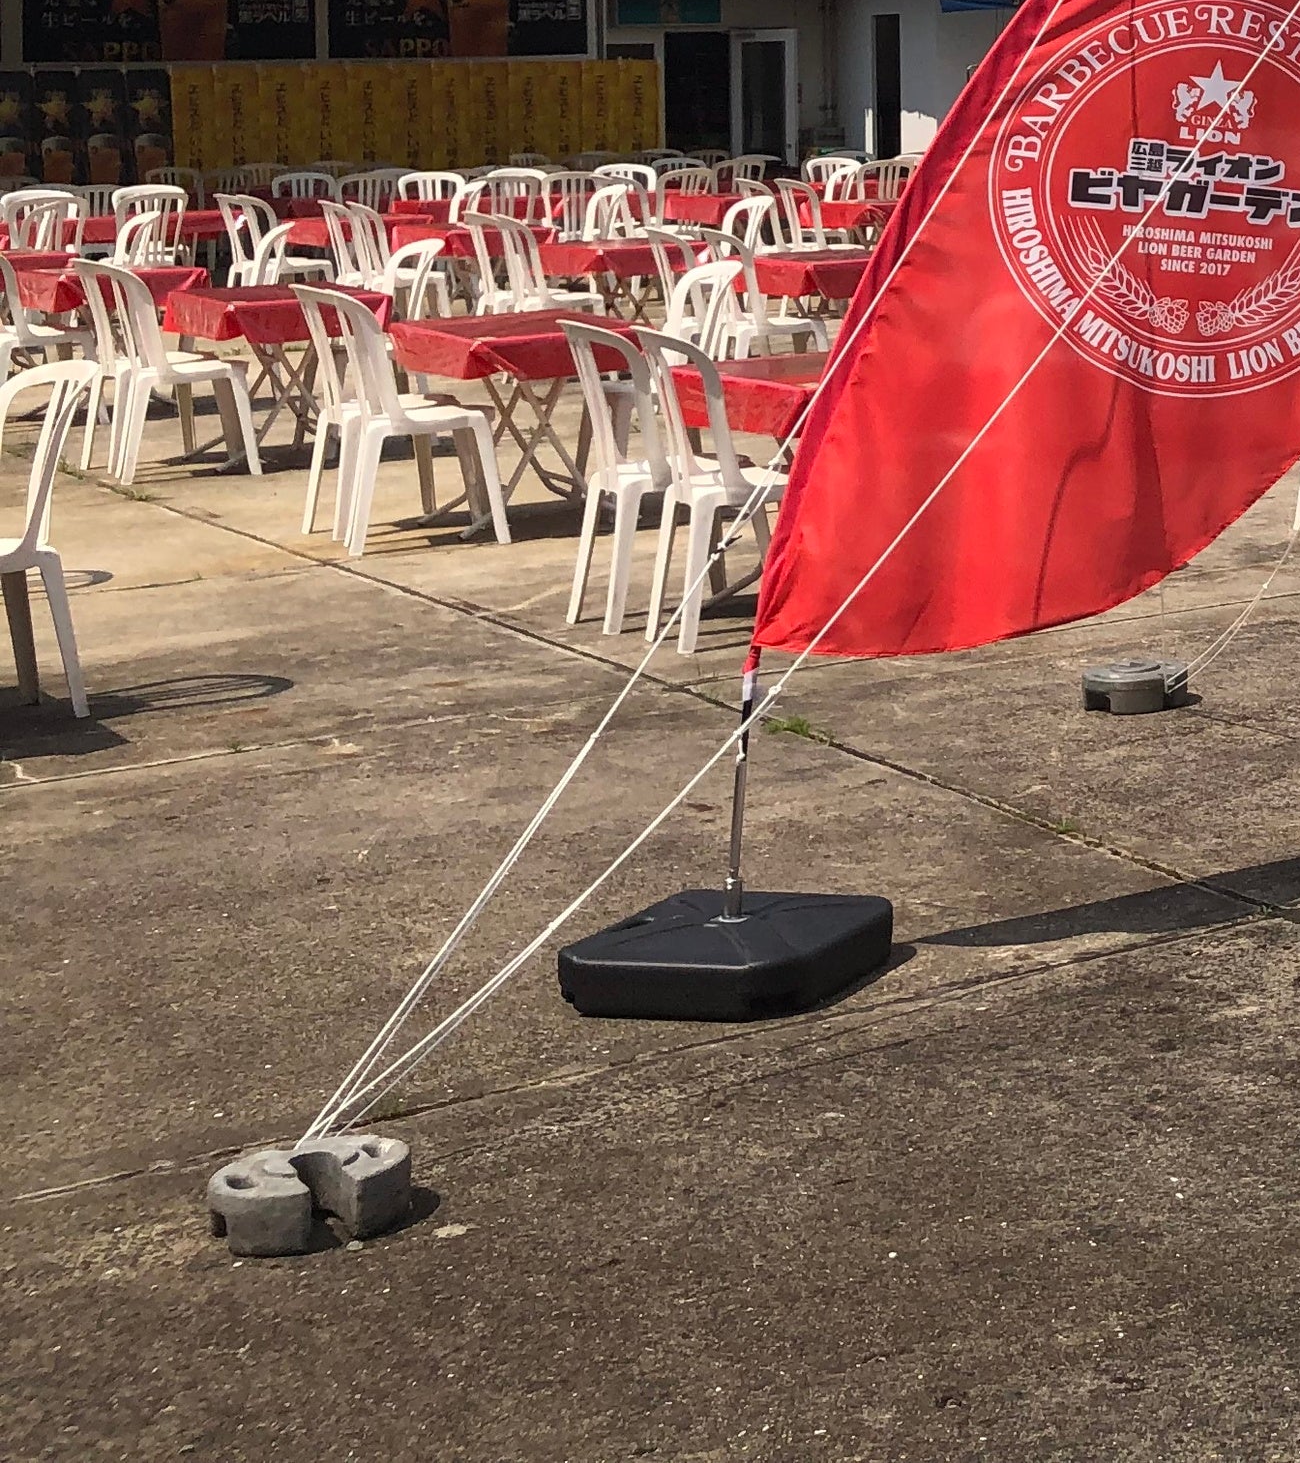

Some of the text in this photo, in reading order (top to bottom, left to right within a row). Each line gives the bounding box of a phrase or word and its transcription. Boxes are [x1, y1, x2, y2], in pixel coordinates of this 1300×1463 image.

[1005, 7, 1194, 172] BARBECUE
[1190, 114, 1234, 130] GINZA
[1179, 126, 1241, 145] LION
[1165, 147, 1282, 181] ライオン
[1122, 224, 1273, 251] HIROSHIMA MITSUKOSHI
[1138, 241, 1256, 264] LION BEER GARDEN
[1160, 258, 1232, 276] SINCE 2017
[1001, 186, 1080, 320] HIROSHIMA
[1073, 308, 1216, 384] MITSUKOSHI
[1227, 338, 1285, 380] LION
